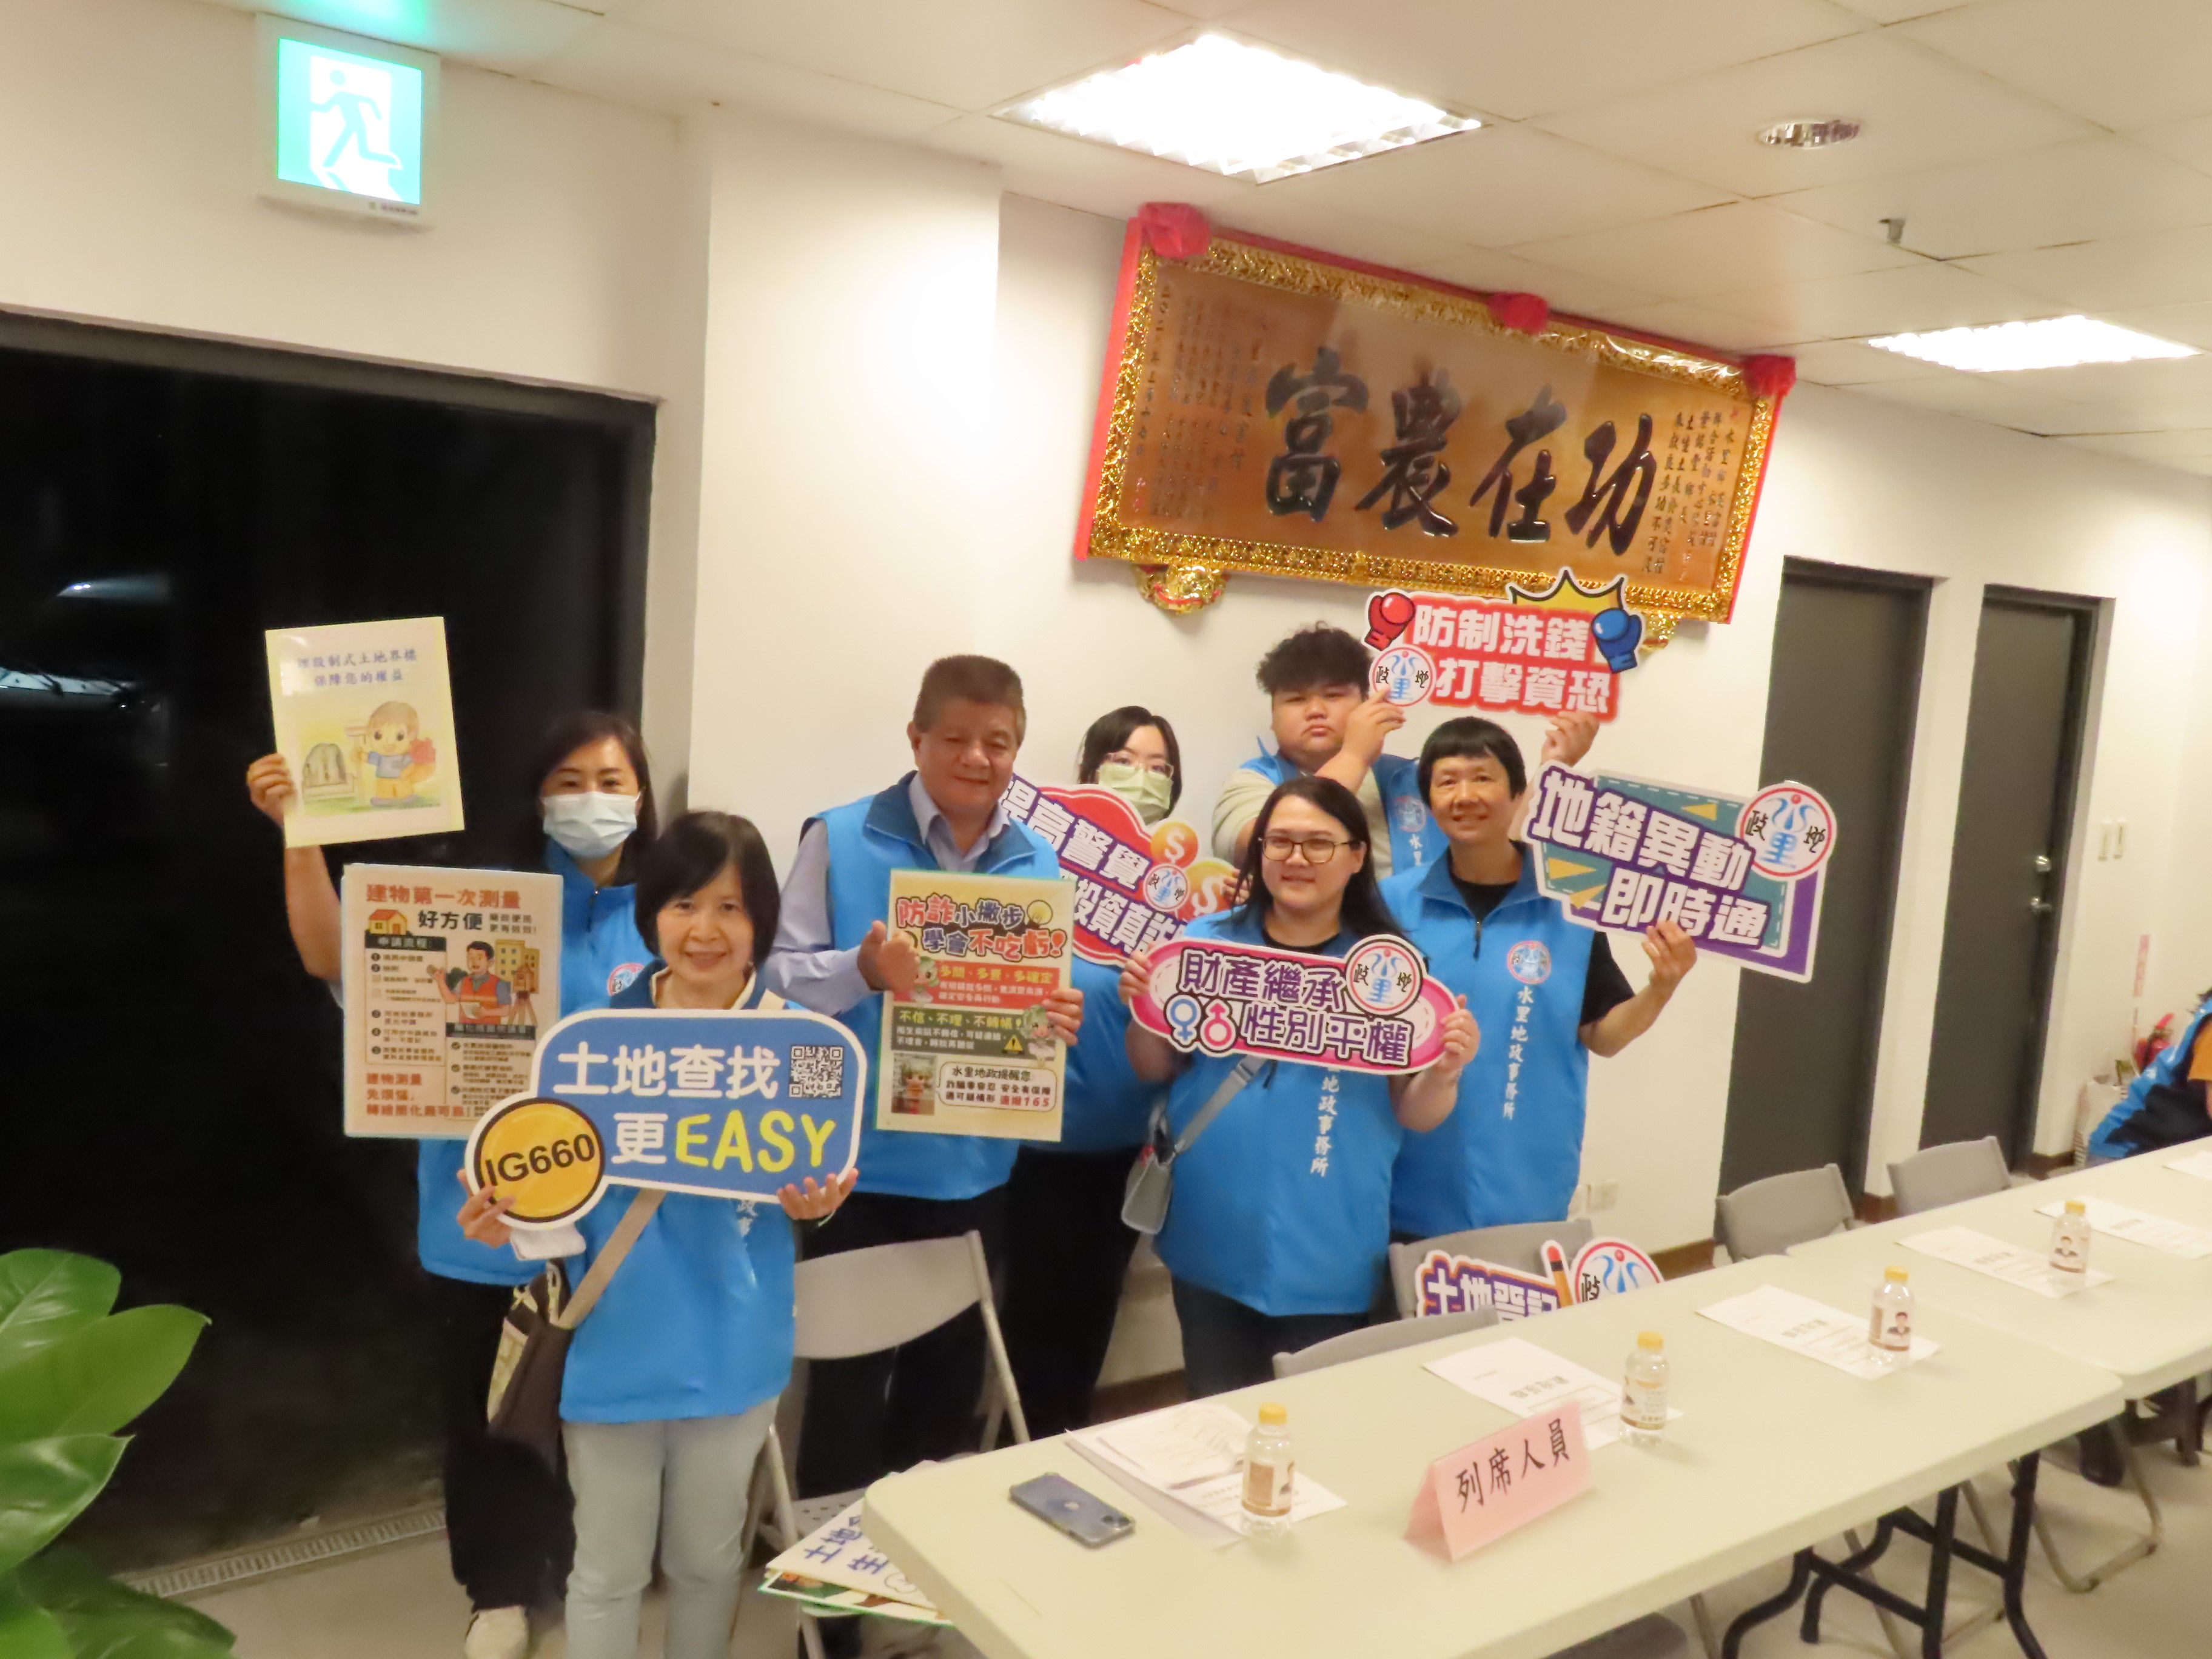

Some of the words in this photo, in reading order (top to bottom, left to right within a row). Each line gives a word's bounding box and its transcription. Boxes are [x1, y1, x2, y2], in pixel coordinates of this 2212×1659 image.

[1413, 605, 1589, 662] 防制洗錢
[1436, 657, 1611, 714] 打擊資恐
[1531, 772, 1752, 891] 地籍異動
[366, 883, 521, 910] 建物第一次測量
[418, 910, 483, 931] 好方便
[897, 893, 1025, 929] 防詐小撇步
[1600, 866, 1769, 946] 即時通
[1180, 951, 1346, 1011] 財產繼承
[1242, 1002, 1410, 1065] 性別平權
[553, 1041, 781, 1100] 土地查找
[484, 1131, 597, 1187] IG660
[1455, 1418, 1570, 1513] 列席人員
